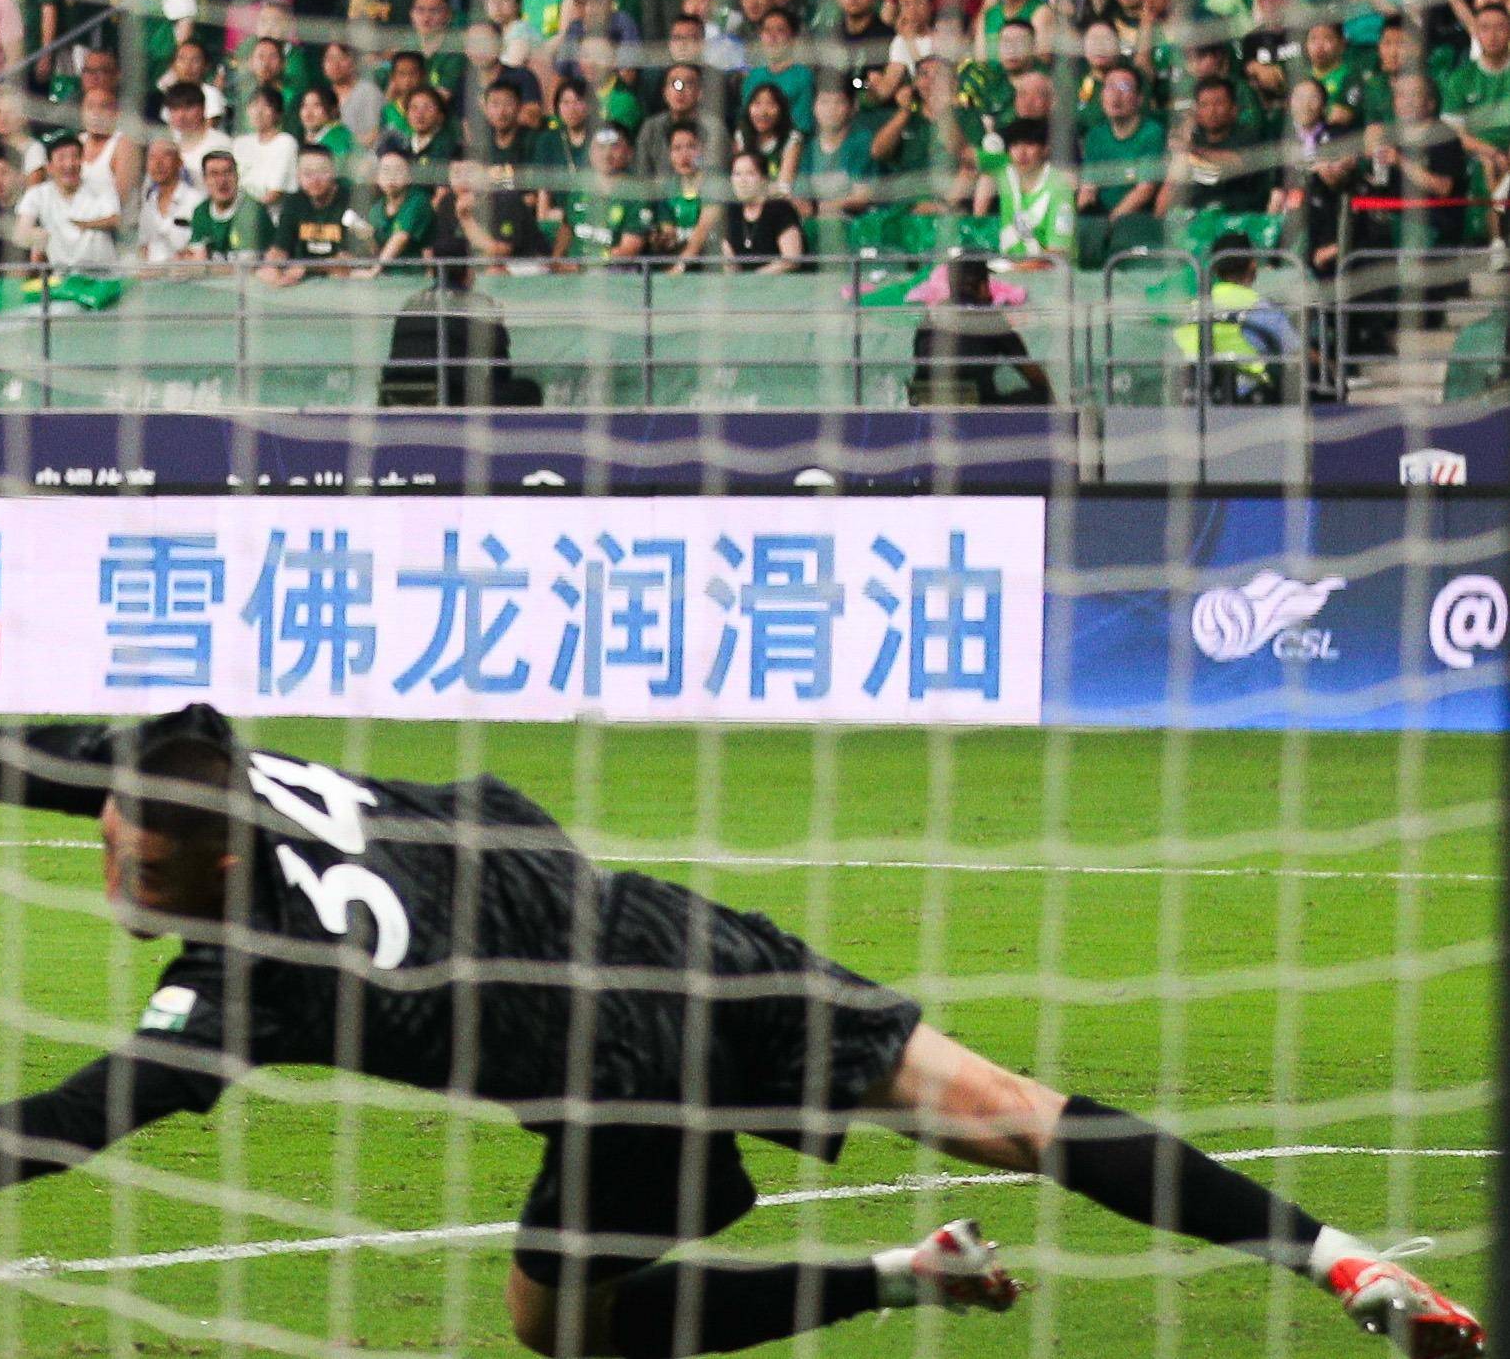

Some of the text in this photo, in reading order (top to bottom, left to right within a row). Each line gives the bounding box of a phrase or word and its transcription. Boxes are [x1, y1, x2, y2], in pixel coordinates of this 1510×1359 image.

[99, 529, 1002, 701] 雪佛龙润滑油
[248, 751, 410, 970] 34
